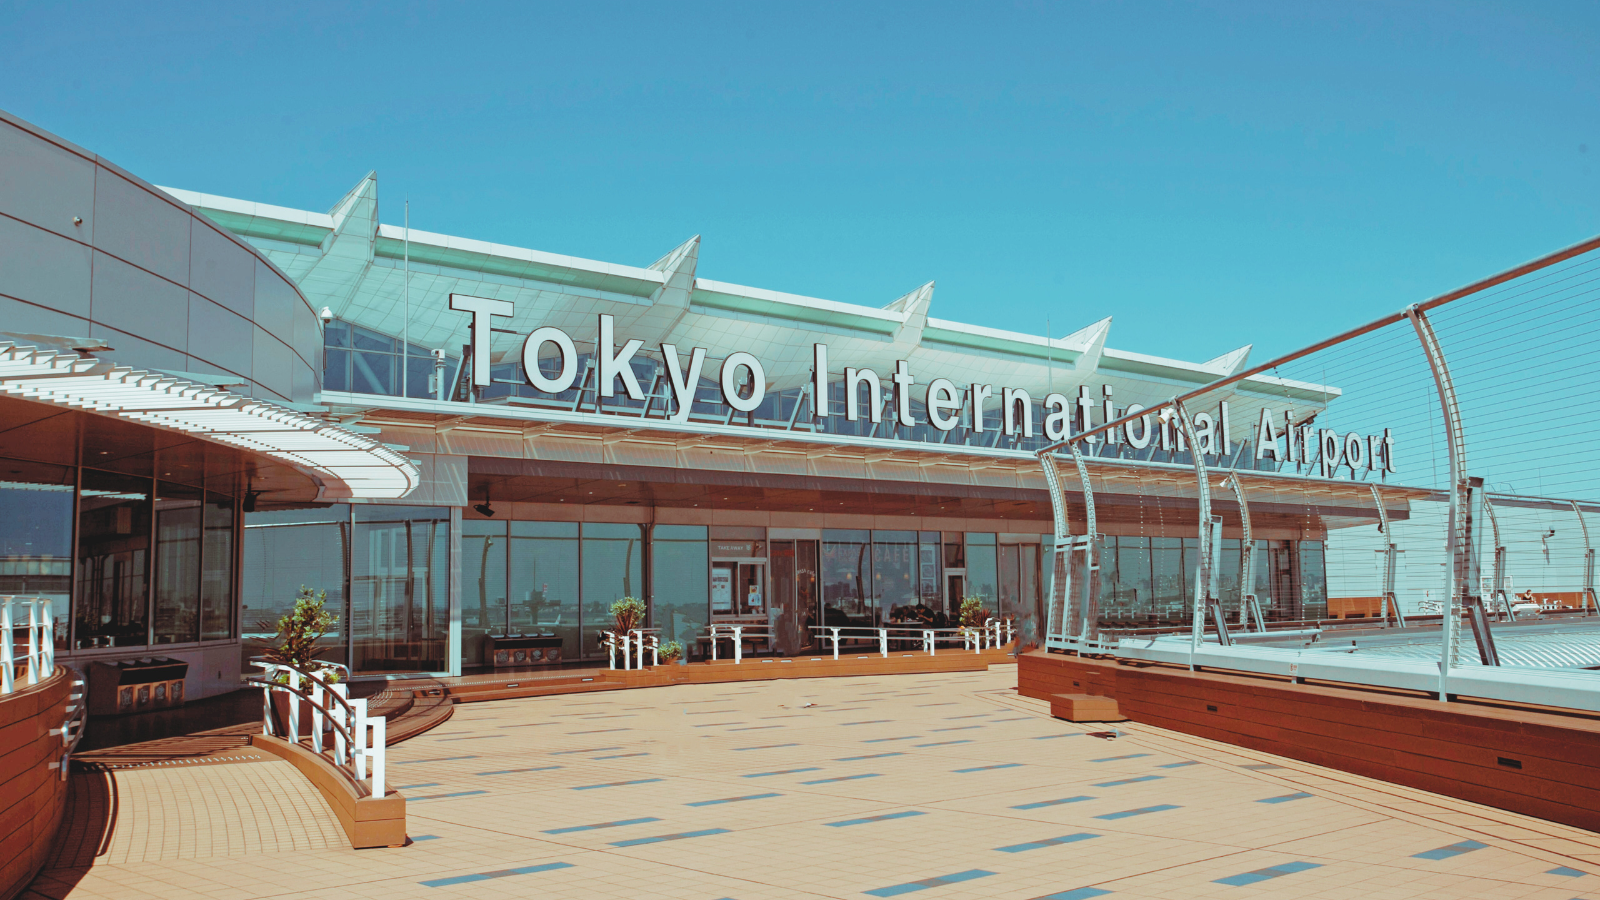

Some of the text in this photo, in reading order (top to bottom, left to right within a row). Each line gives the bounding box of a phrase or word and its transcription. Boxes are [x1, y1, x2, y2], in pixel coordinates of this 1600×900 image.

[449, 293, 1397, 478] Tokyo International Airport
